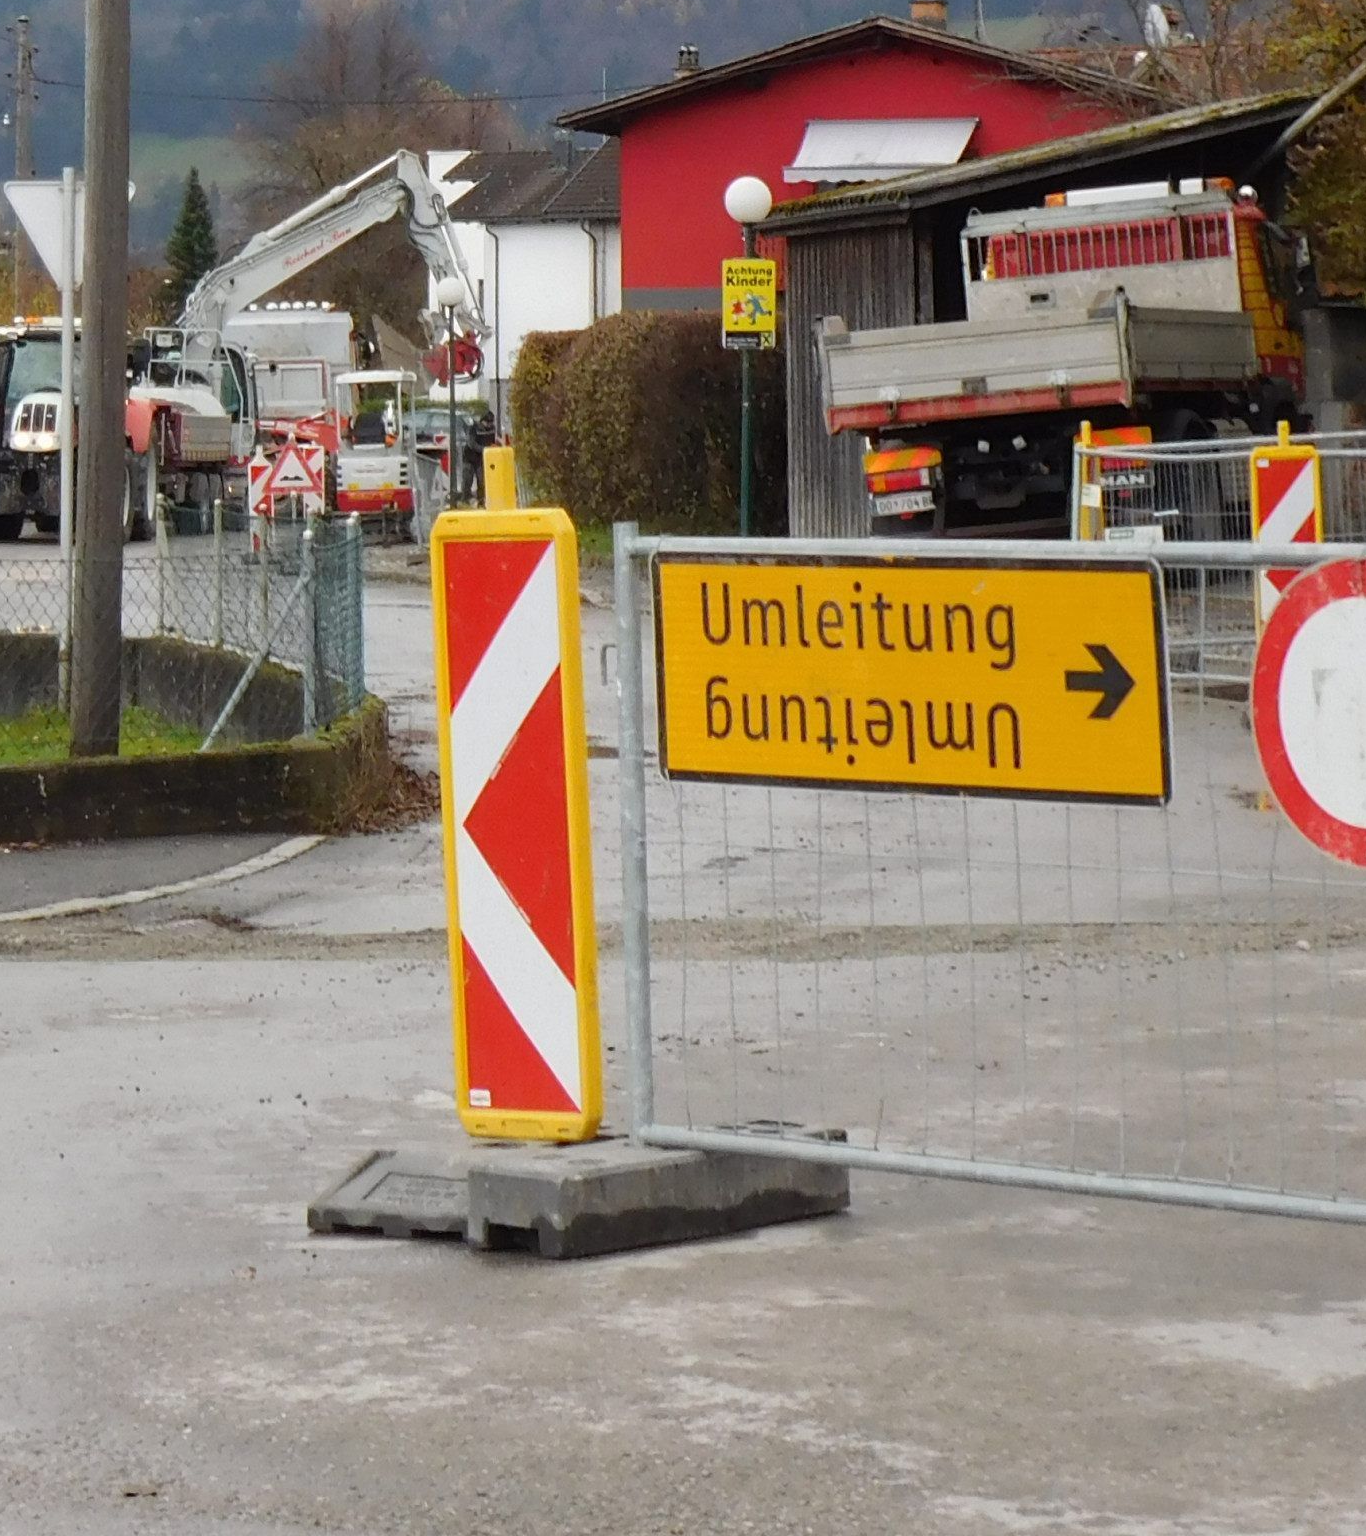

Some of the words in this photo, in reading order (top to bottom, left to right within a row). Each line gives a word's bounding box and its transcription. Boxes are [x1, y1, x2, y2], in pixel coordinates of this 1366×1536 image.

[726, 266, 773, 277] Achtung
[726, 275, 773, 287] Kinder
[1099, 473, 1146, 486] MAN
[700, 581, 1018, 671] Umleitung
[706, 675, 1022, 769] Umleitung
